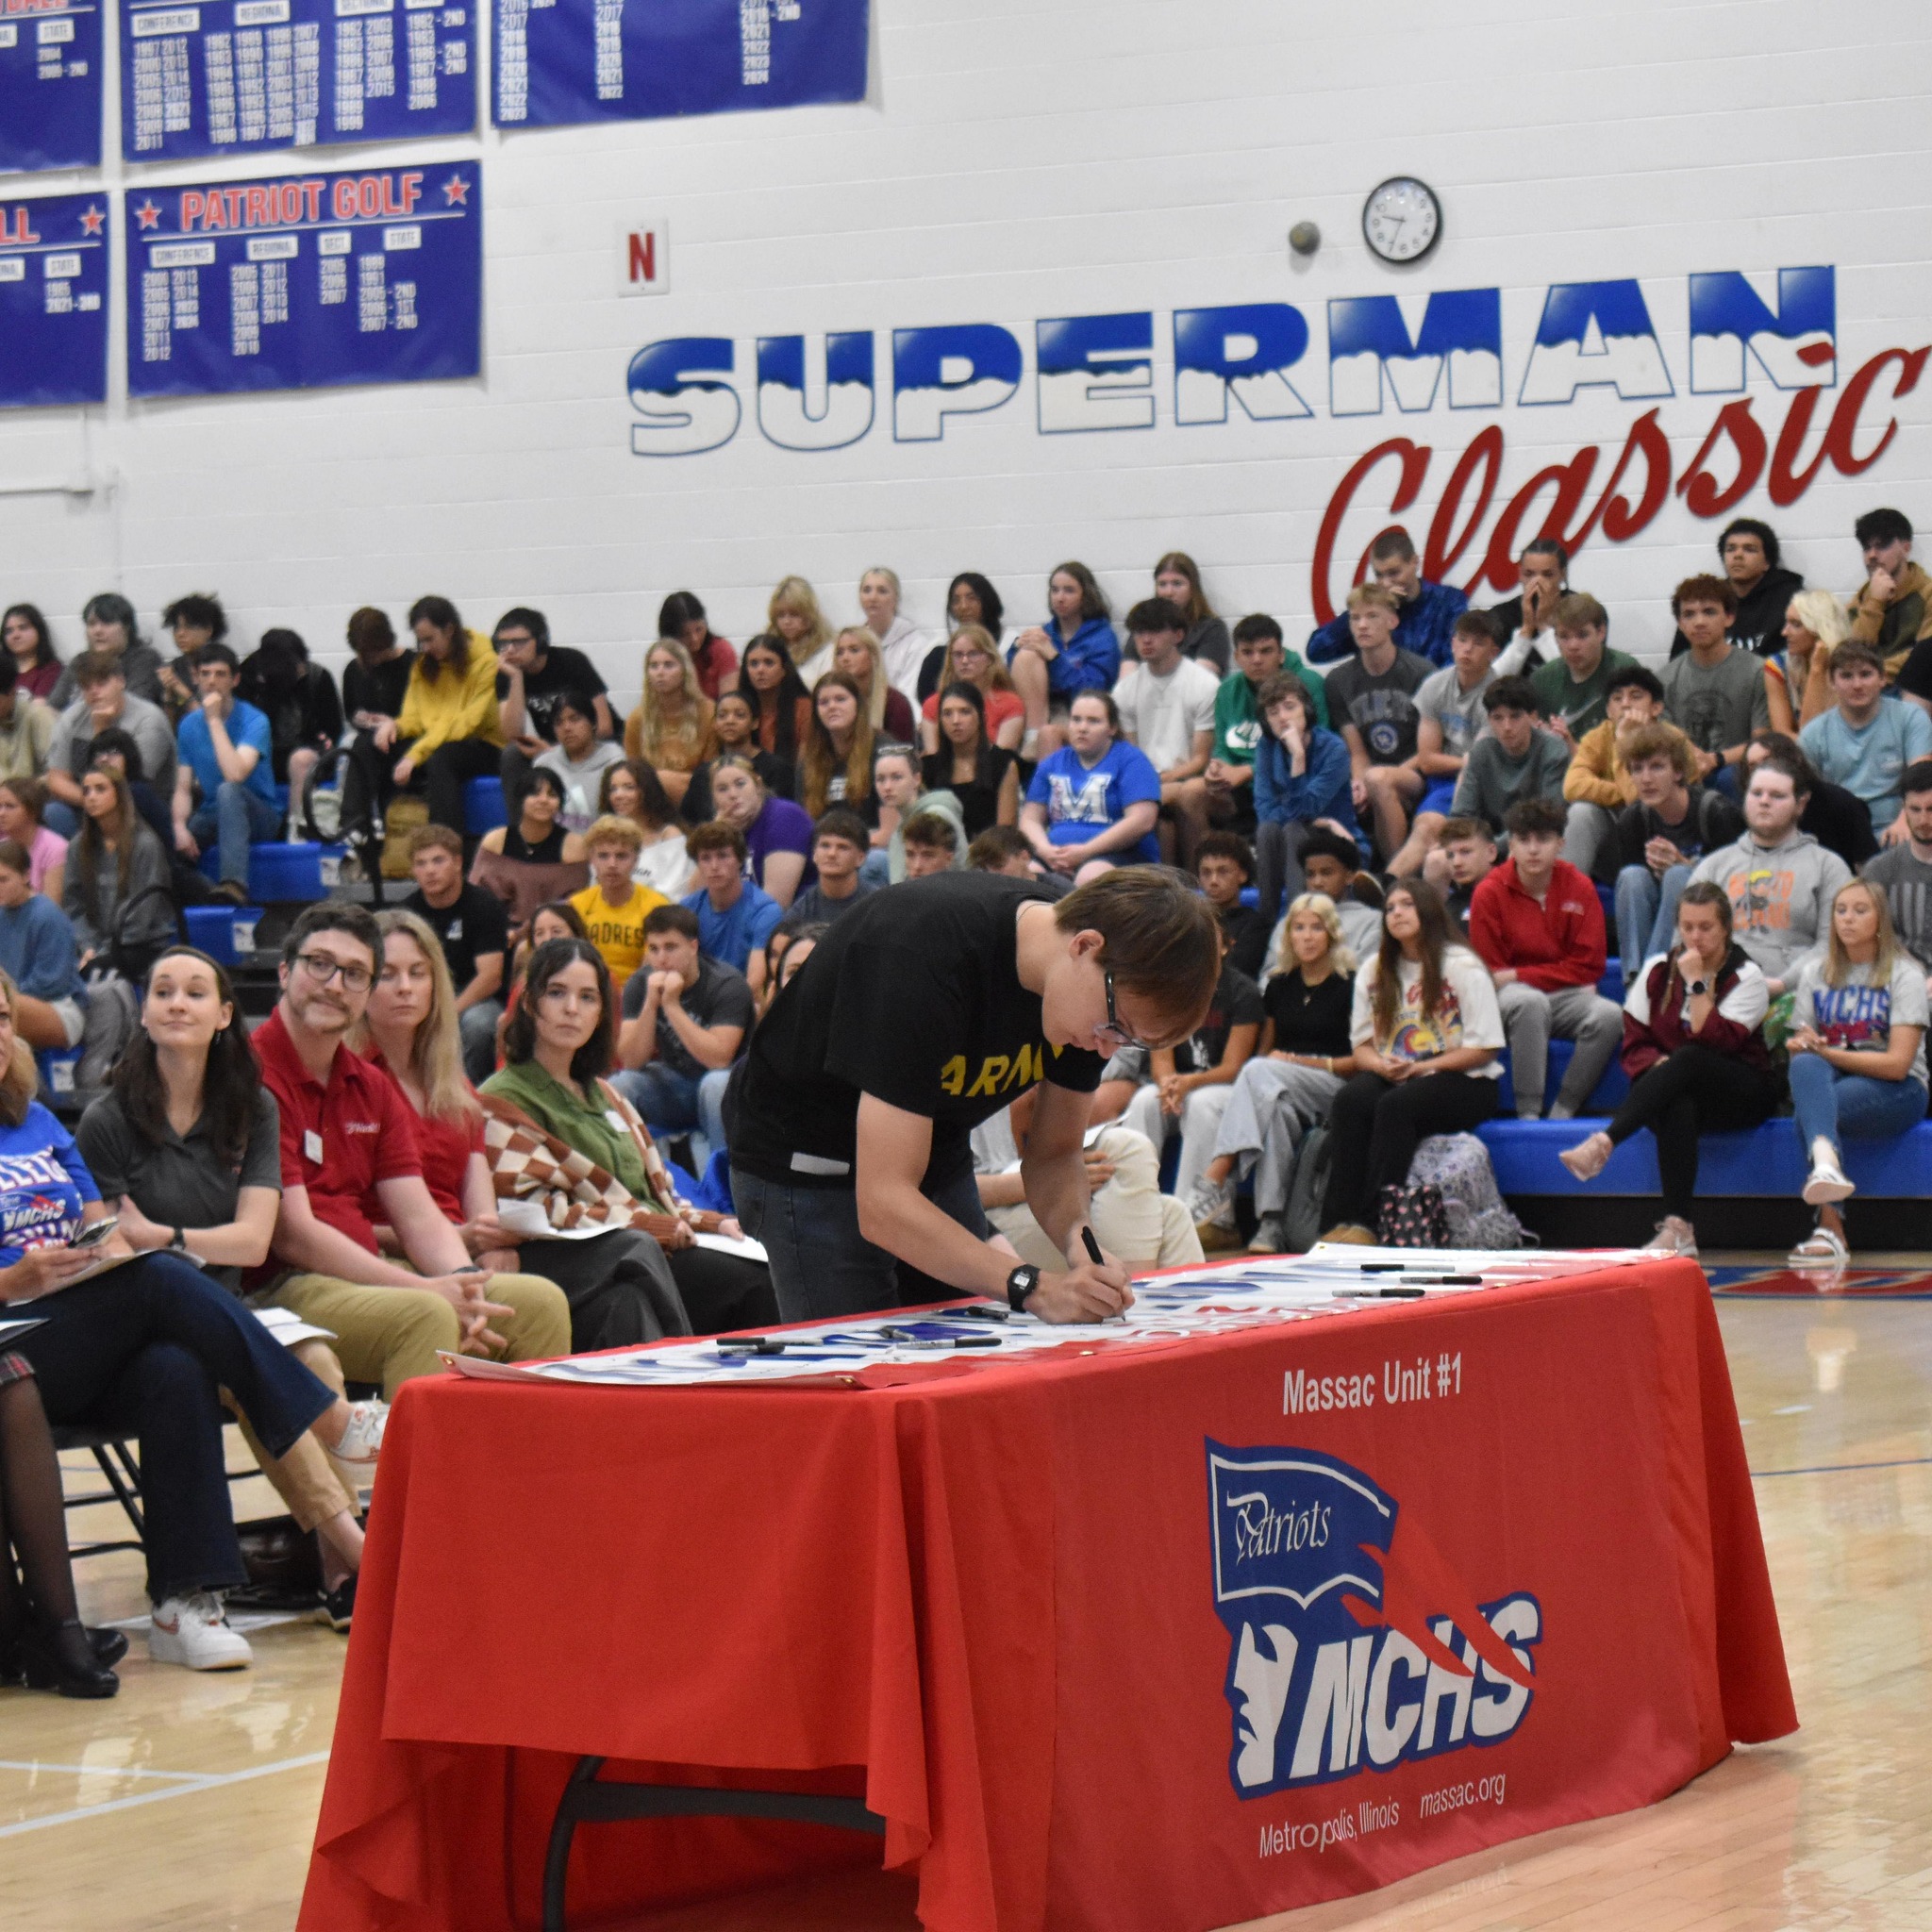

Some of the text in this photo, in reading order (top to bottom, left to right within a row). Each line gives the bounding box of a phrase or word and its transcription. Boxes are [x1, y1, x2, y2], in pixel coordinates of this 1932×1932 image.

[500, 13, 527, 30] 2017
[595, 5, 624, 22] 2017
[366, 81, 394, 98] 2015
[181, 173, 424, 232] PATRIOT GOLF
[391, 231, 416, 246] STATE
[628, 231, 656, 282] N
[262, 262, 287, 279] 2011
[262, 278, 288, 293] 2012
[144, 346, 171, 361] 2012
[626, 264, 1837, 457] SUPERMAN
[1311, 341, 1932, 626] Classic
[589, 922, 644, 949] ADRES
[1813, 985, 1890, 1026] MCHS
[941, 1042, 1064, 1097] ARM
[1283, 1352, 1463, 1416] Massac Unit #1
[1226, 1491, 1331, 1566] Patriots
[1289, 1599, 1540, 1780] MCHS
[1258, 1773, 1507, 1859] Metropolis, Illinois massac.org
